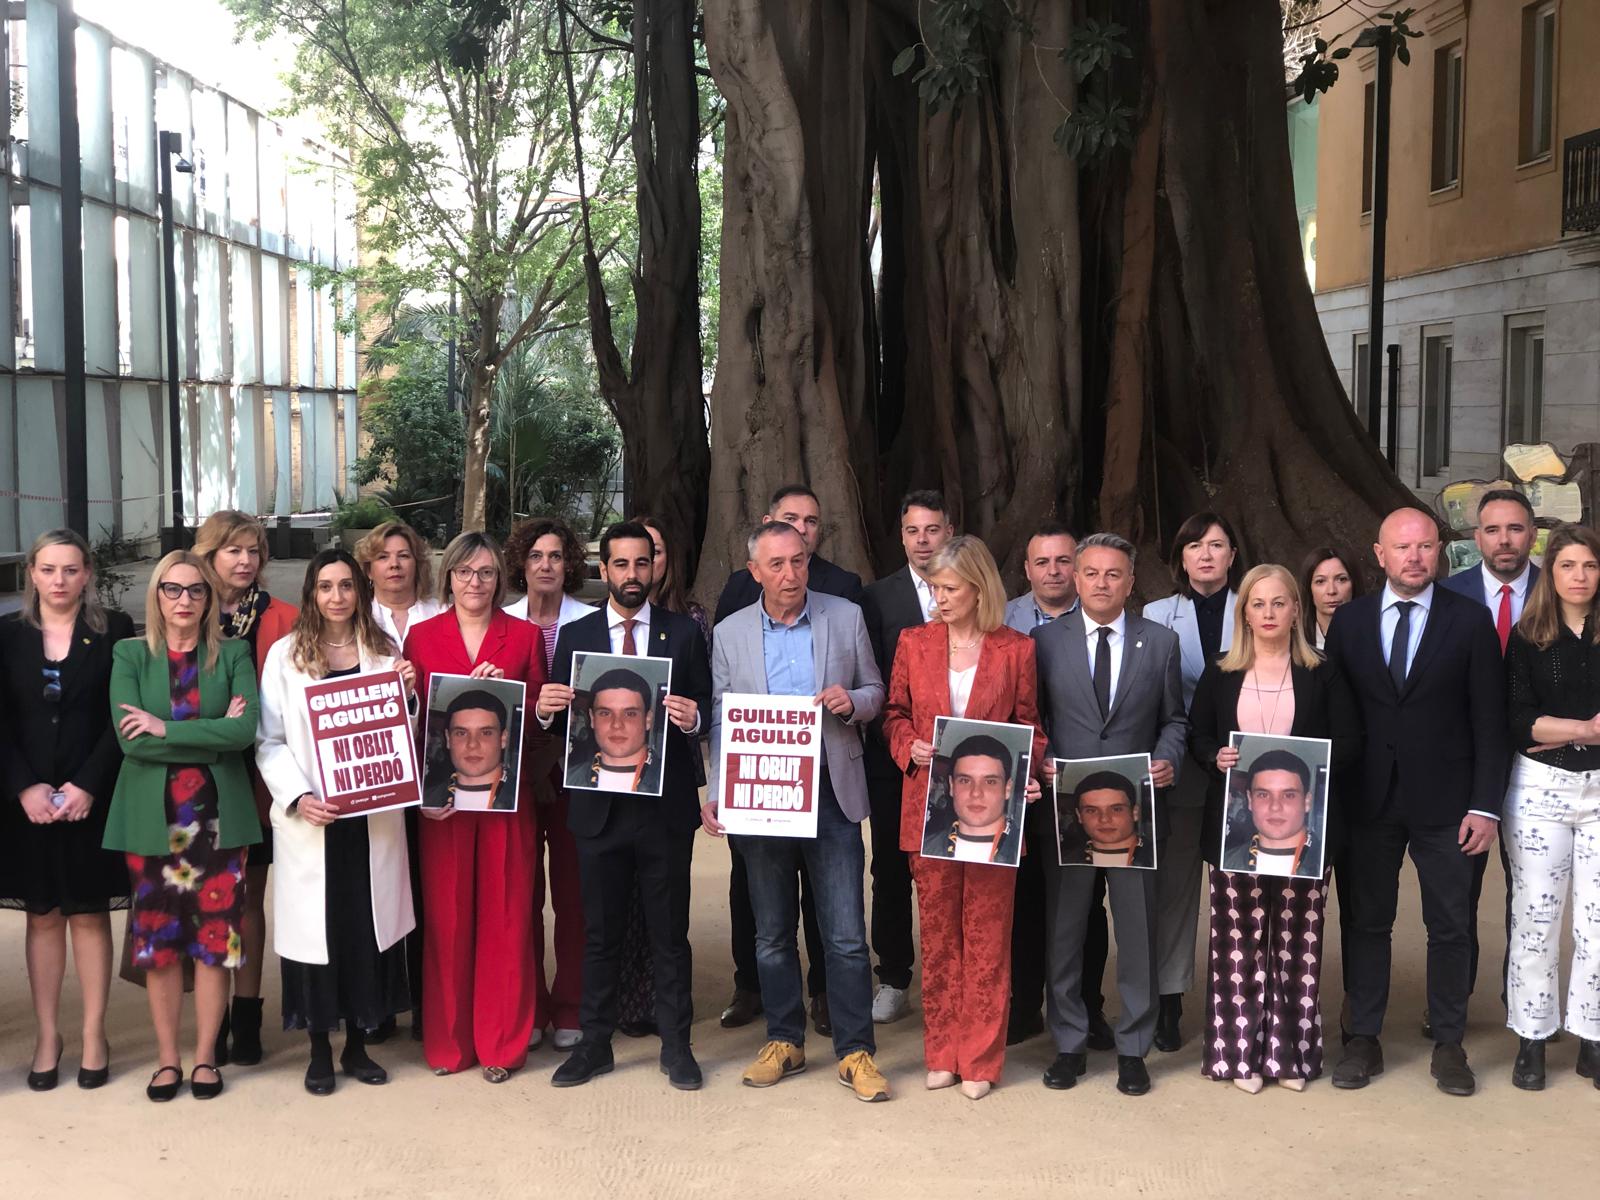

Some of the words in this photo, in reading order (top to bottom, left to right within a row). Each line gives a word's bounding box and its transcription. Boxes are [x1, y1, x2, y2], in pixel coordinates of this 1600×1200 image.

[309, 681, 399, 711] GUILLEM
[318, 697, 400, 731] AGULLÓ
[728, 708, 816, 725] GUILLEM
[332, 737, 352, 764] NI
[352, 730, 394, 760] OBLIT
[731, 726, 811, 745] AGULLÓ
[333, 768, 353, 792] NI
[353, 751, 404, 789] PERDÓ
[739, 755, 757, 780] NI
[758, 756, 801, 782] OBLIT
[733, 783, 751, 808] NI
[752, 780, 804, 811] PERDÓ
